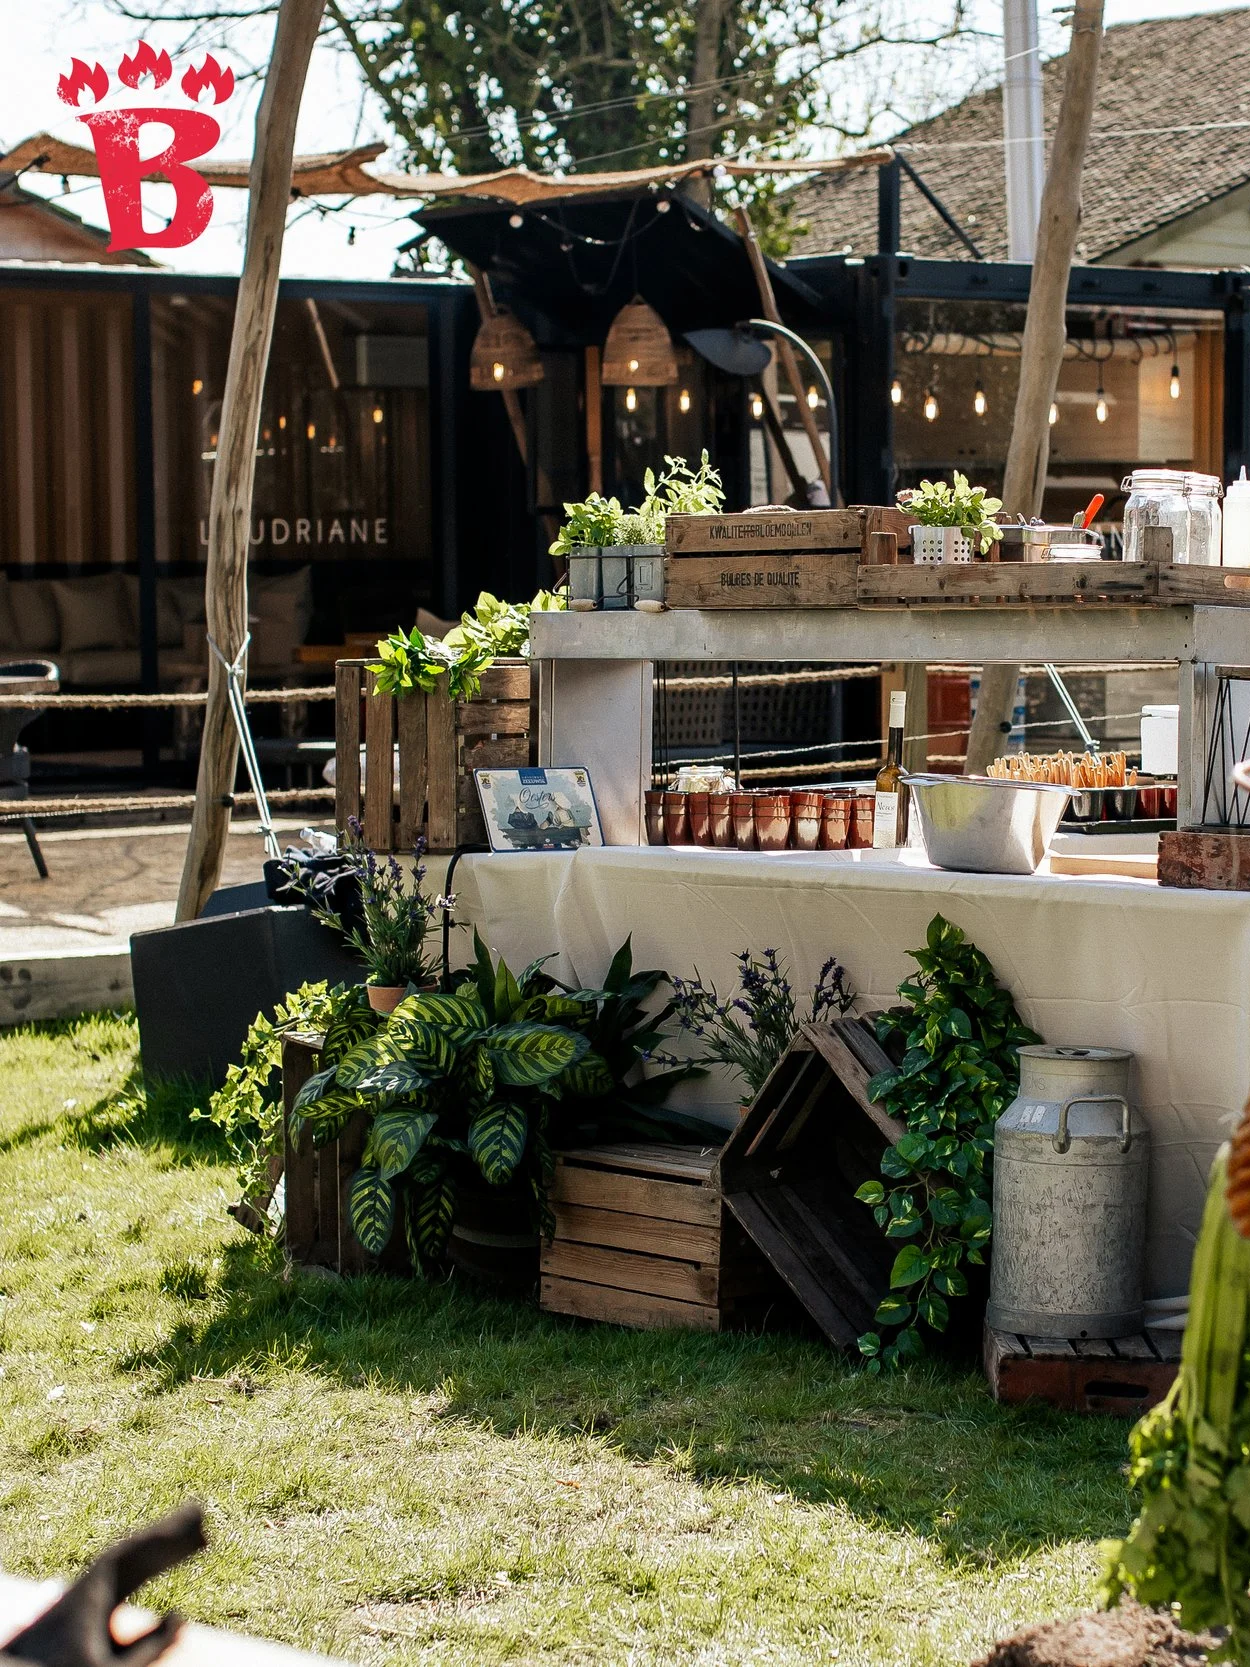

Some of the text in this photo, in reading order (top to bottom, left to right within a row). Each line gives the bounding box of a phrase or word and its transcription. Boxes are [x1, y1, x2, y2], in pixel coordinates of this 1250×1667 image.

[199, 517, 389, 546] LUDRIANE
[720, 571, 752, 587] BULBES
[754, 571, 765, 587] DE
